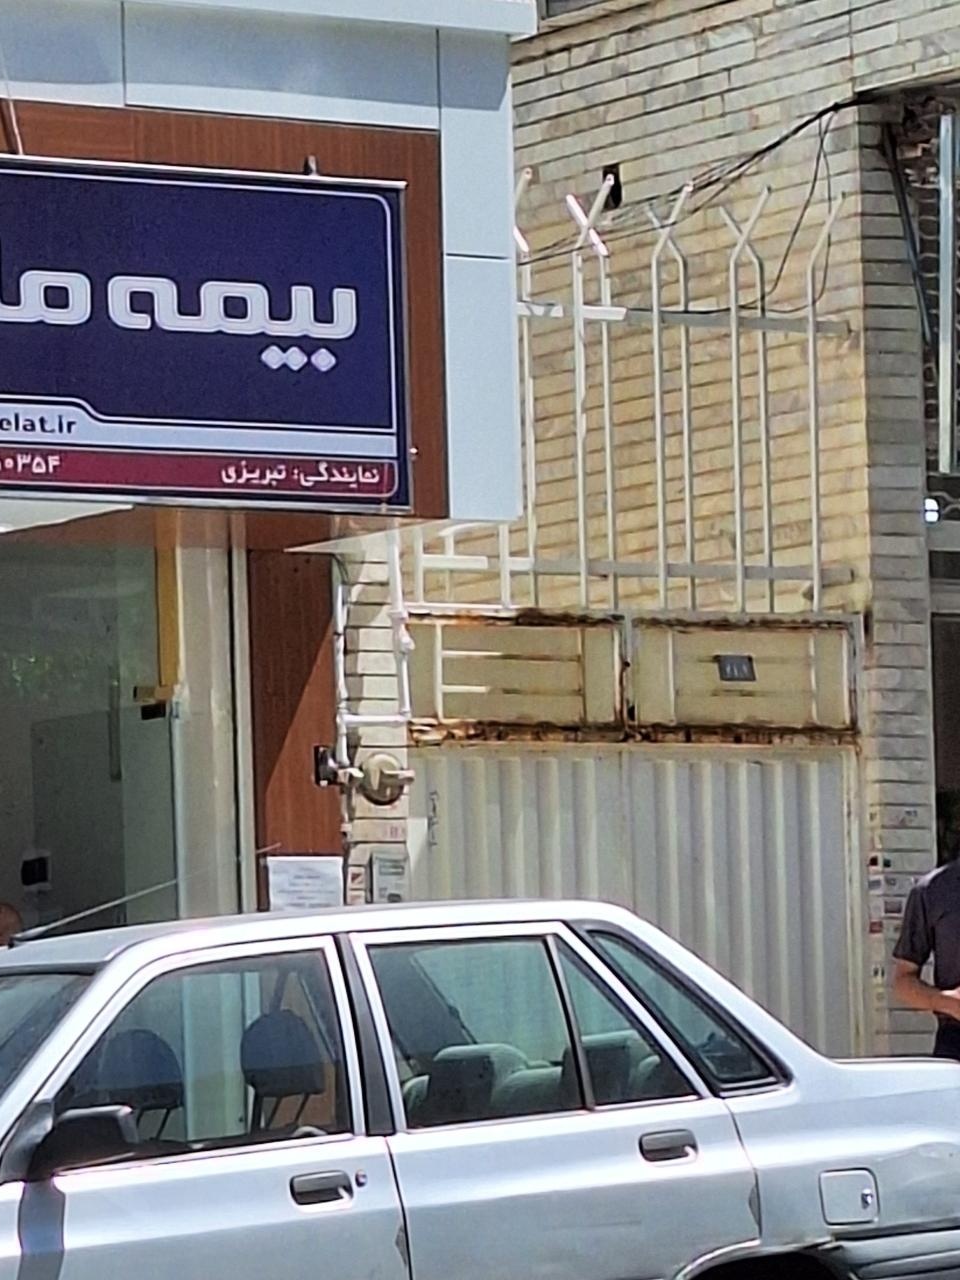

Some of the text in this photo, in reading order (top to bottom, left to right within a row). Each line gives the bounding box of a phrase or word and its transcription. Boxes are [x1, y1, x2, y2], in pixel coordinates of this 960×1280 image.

[107, 275, 358, 373] بیمه
[220, 459, 380, 488] نمایندگی: تبریزی
